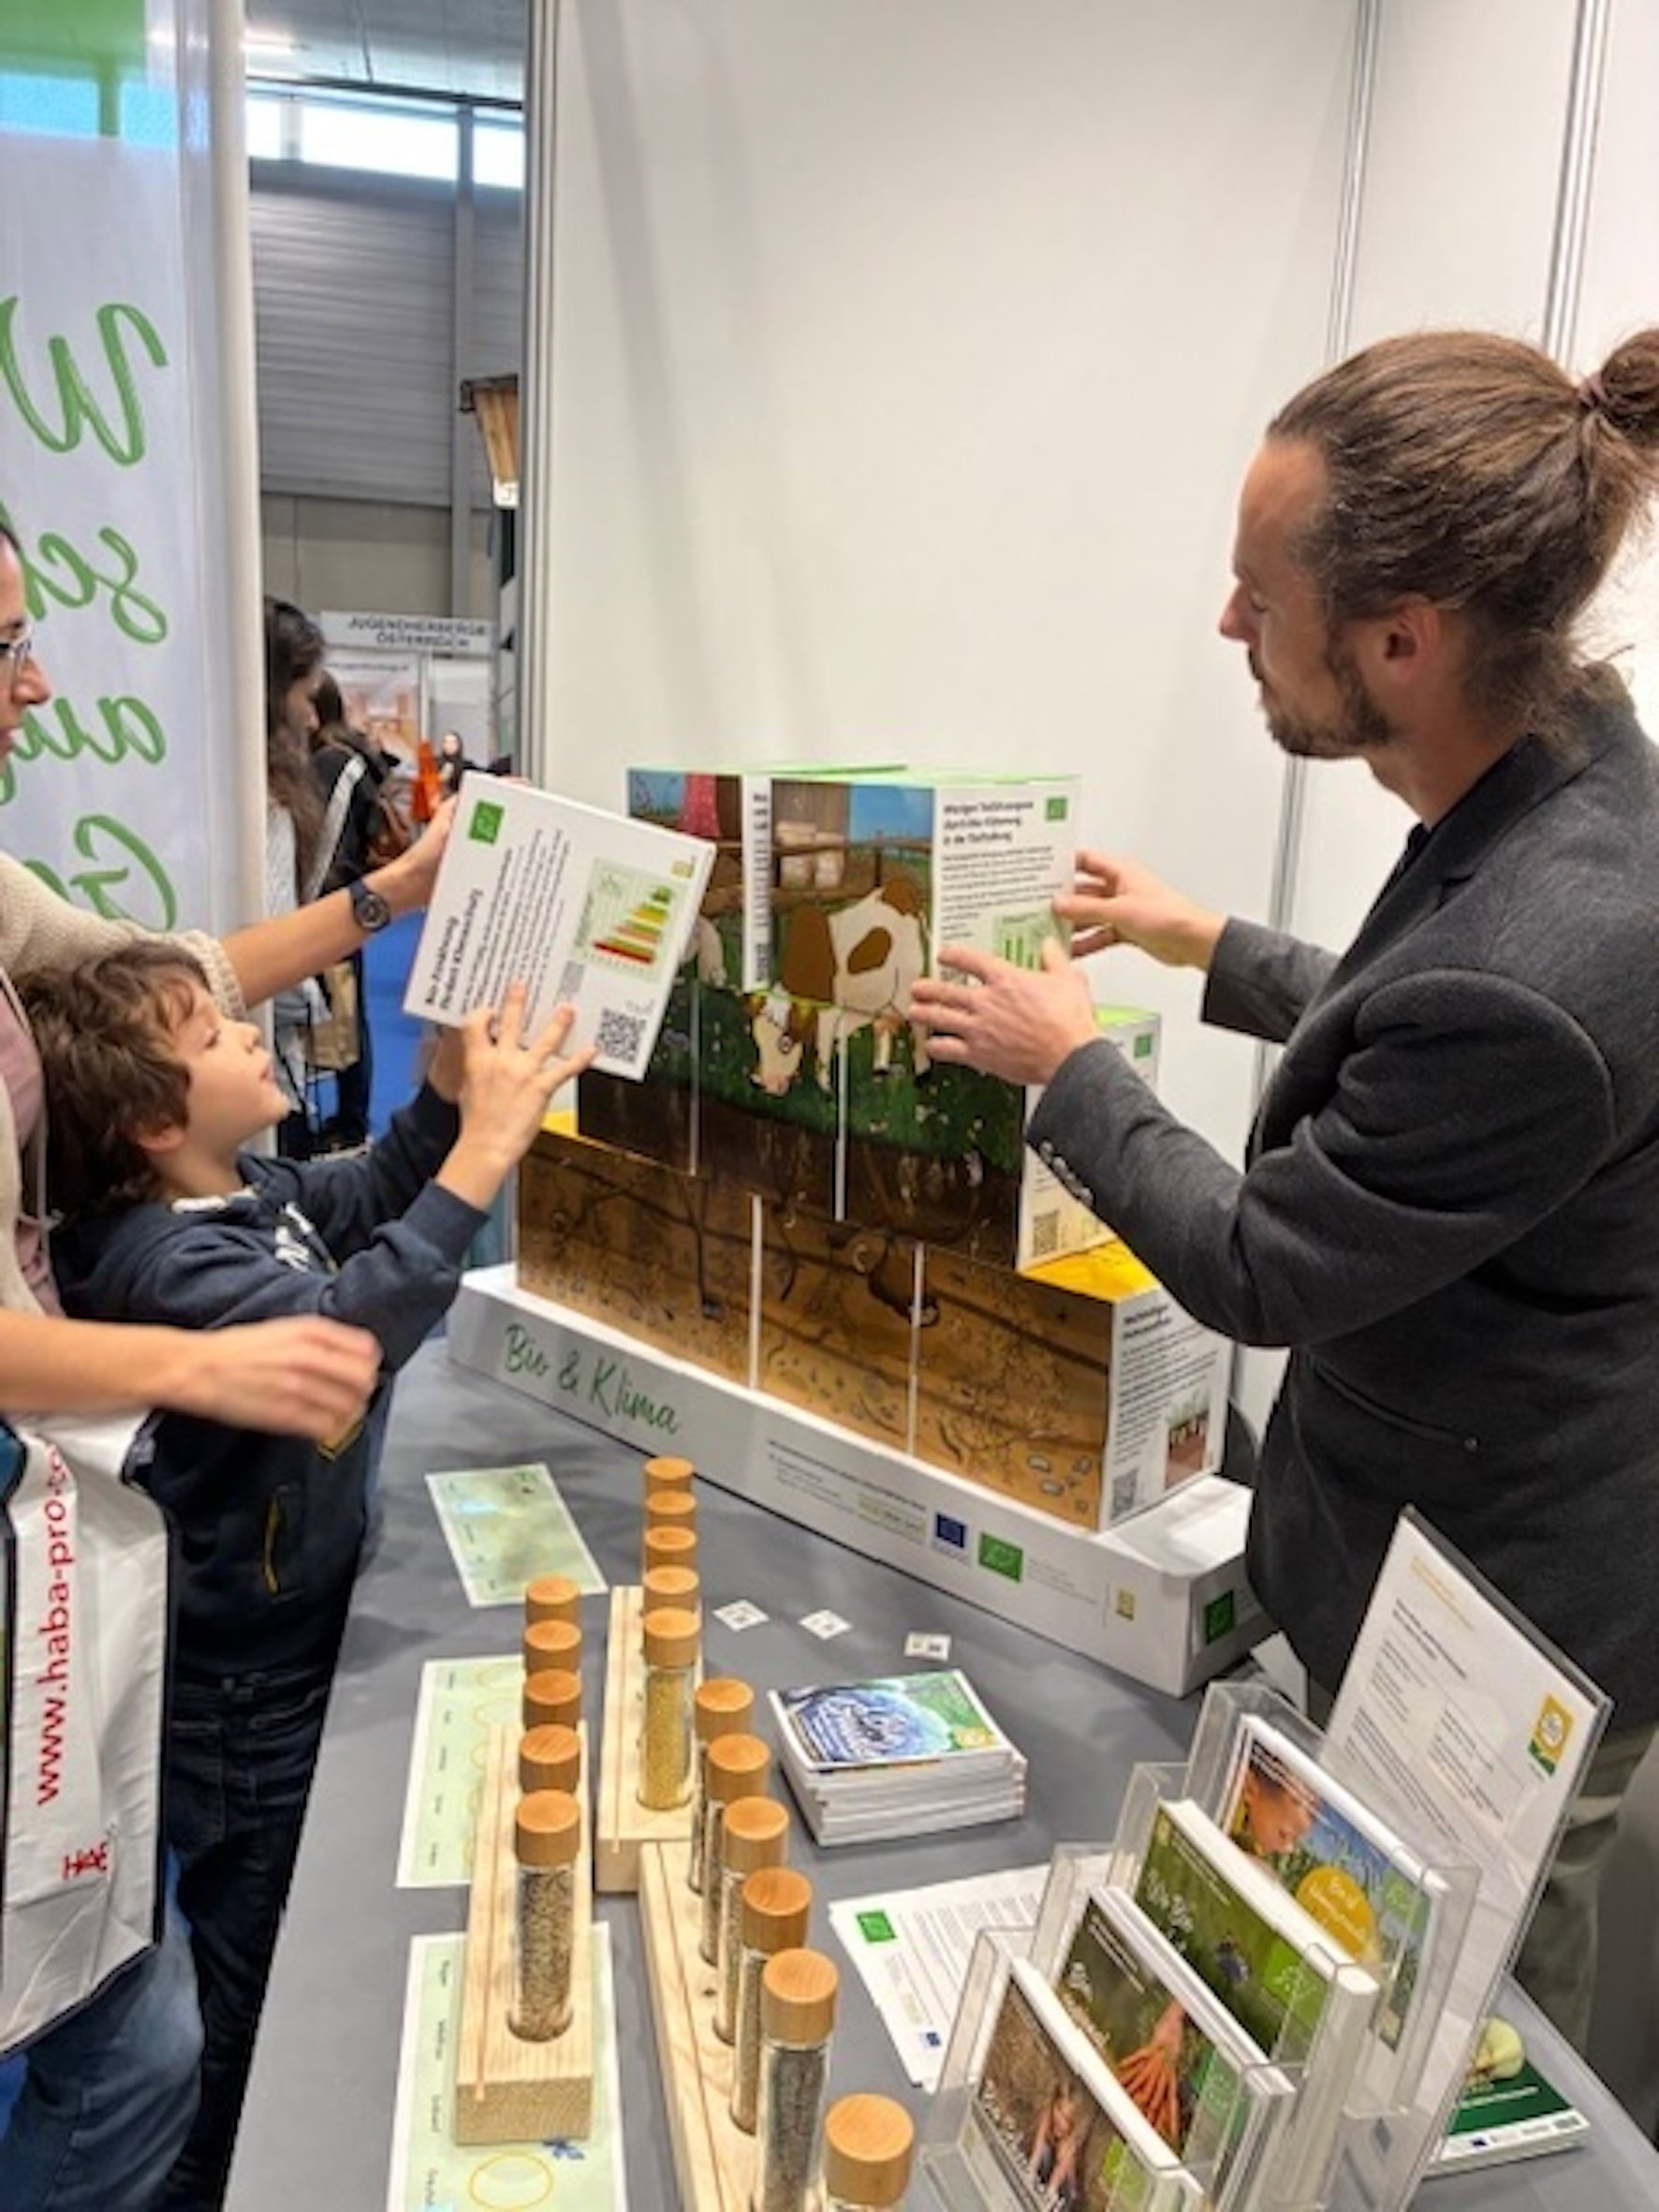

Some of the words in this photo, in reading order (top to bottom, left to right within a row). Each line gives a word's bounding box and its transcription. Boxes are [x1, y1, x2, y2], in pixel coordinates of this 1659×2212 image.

[505, 1323, 550, 1377] Bio
[558, 1349, 580, 1394] &
[590, 1357, 679, 1434] Klima
